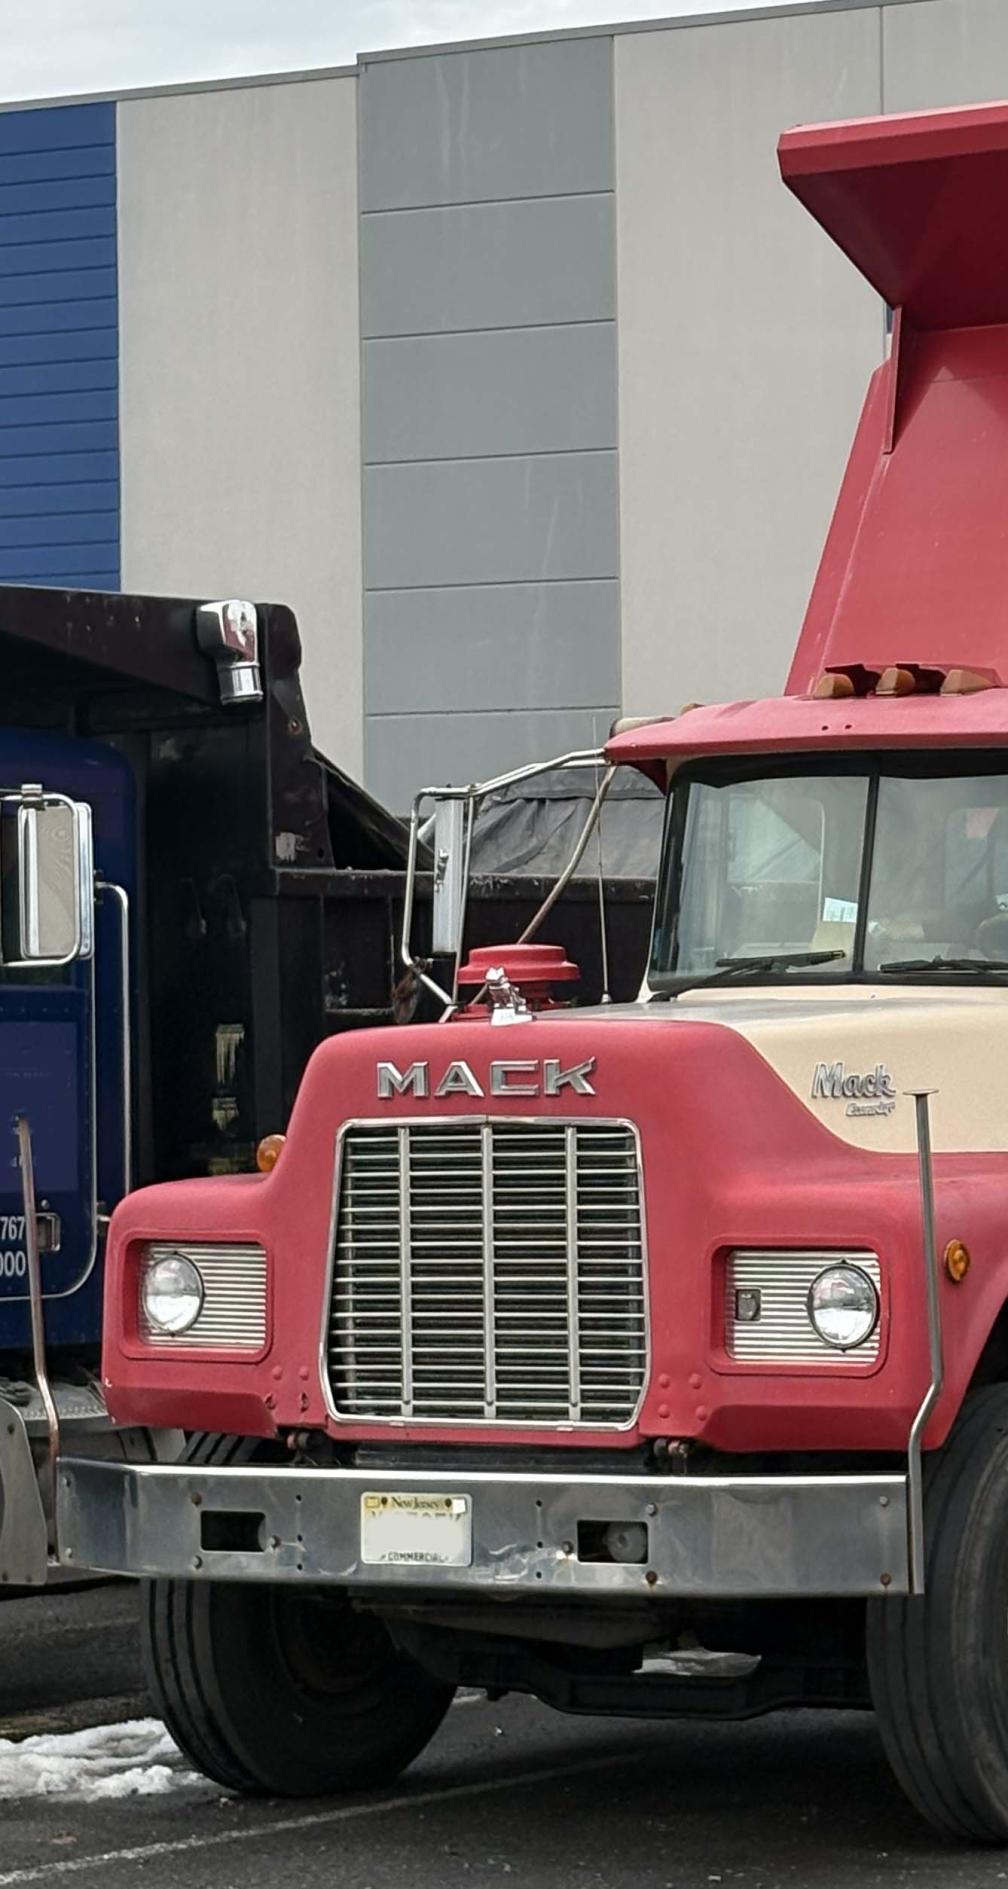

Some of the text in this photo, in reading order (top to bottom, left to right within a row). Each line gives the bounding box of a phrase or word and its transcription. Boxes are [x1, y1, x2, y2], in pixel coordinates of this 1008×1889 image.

[377, 1056, 596, 1098] MACK
[811, 1062, 896, 1099] Mack
[391, 1496, 441, 1510] New Jersey
